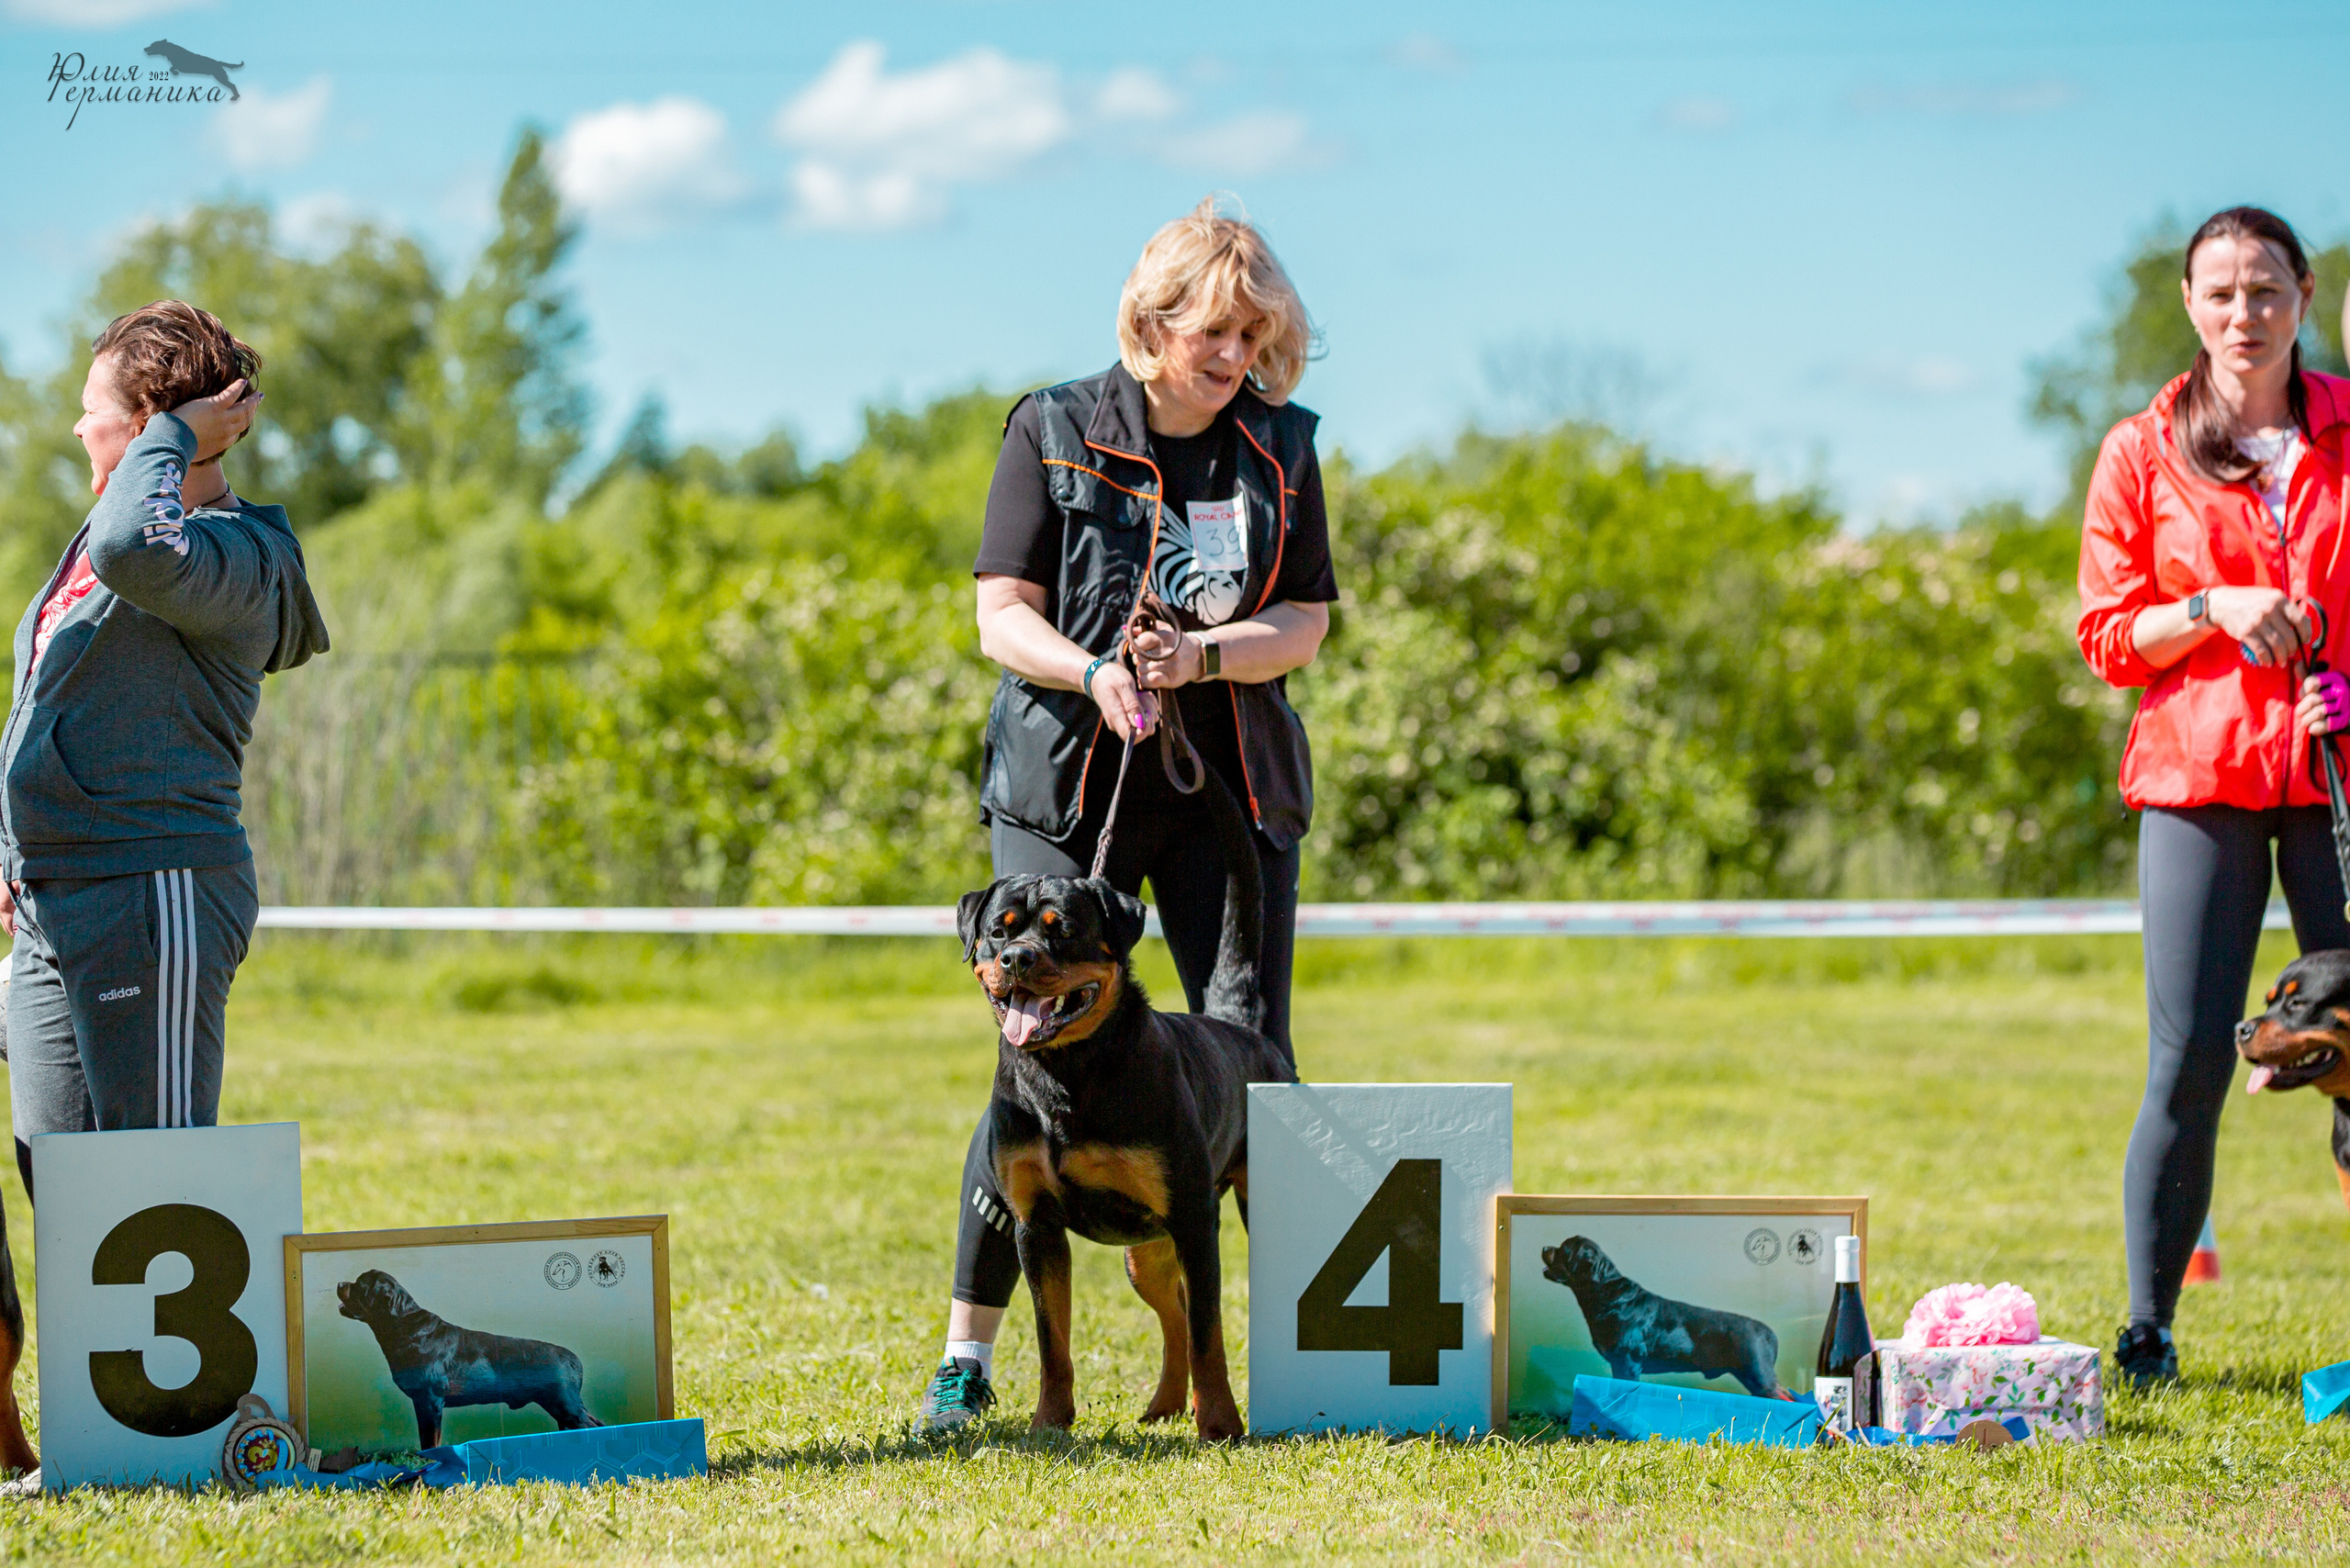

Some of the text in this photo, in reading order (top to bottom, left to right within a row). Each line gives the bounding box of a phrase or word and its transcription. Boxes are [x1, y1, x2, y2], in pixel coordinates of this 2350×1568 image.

[98, 986, 141, 1002] adidas
[89, 1204, 258, 1438] 3
[1297, 1159, 1463, 1385] 4
